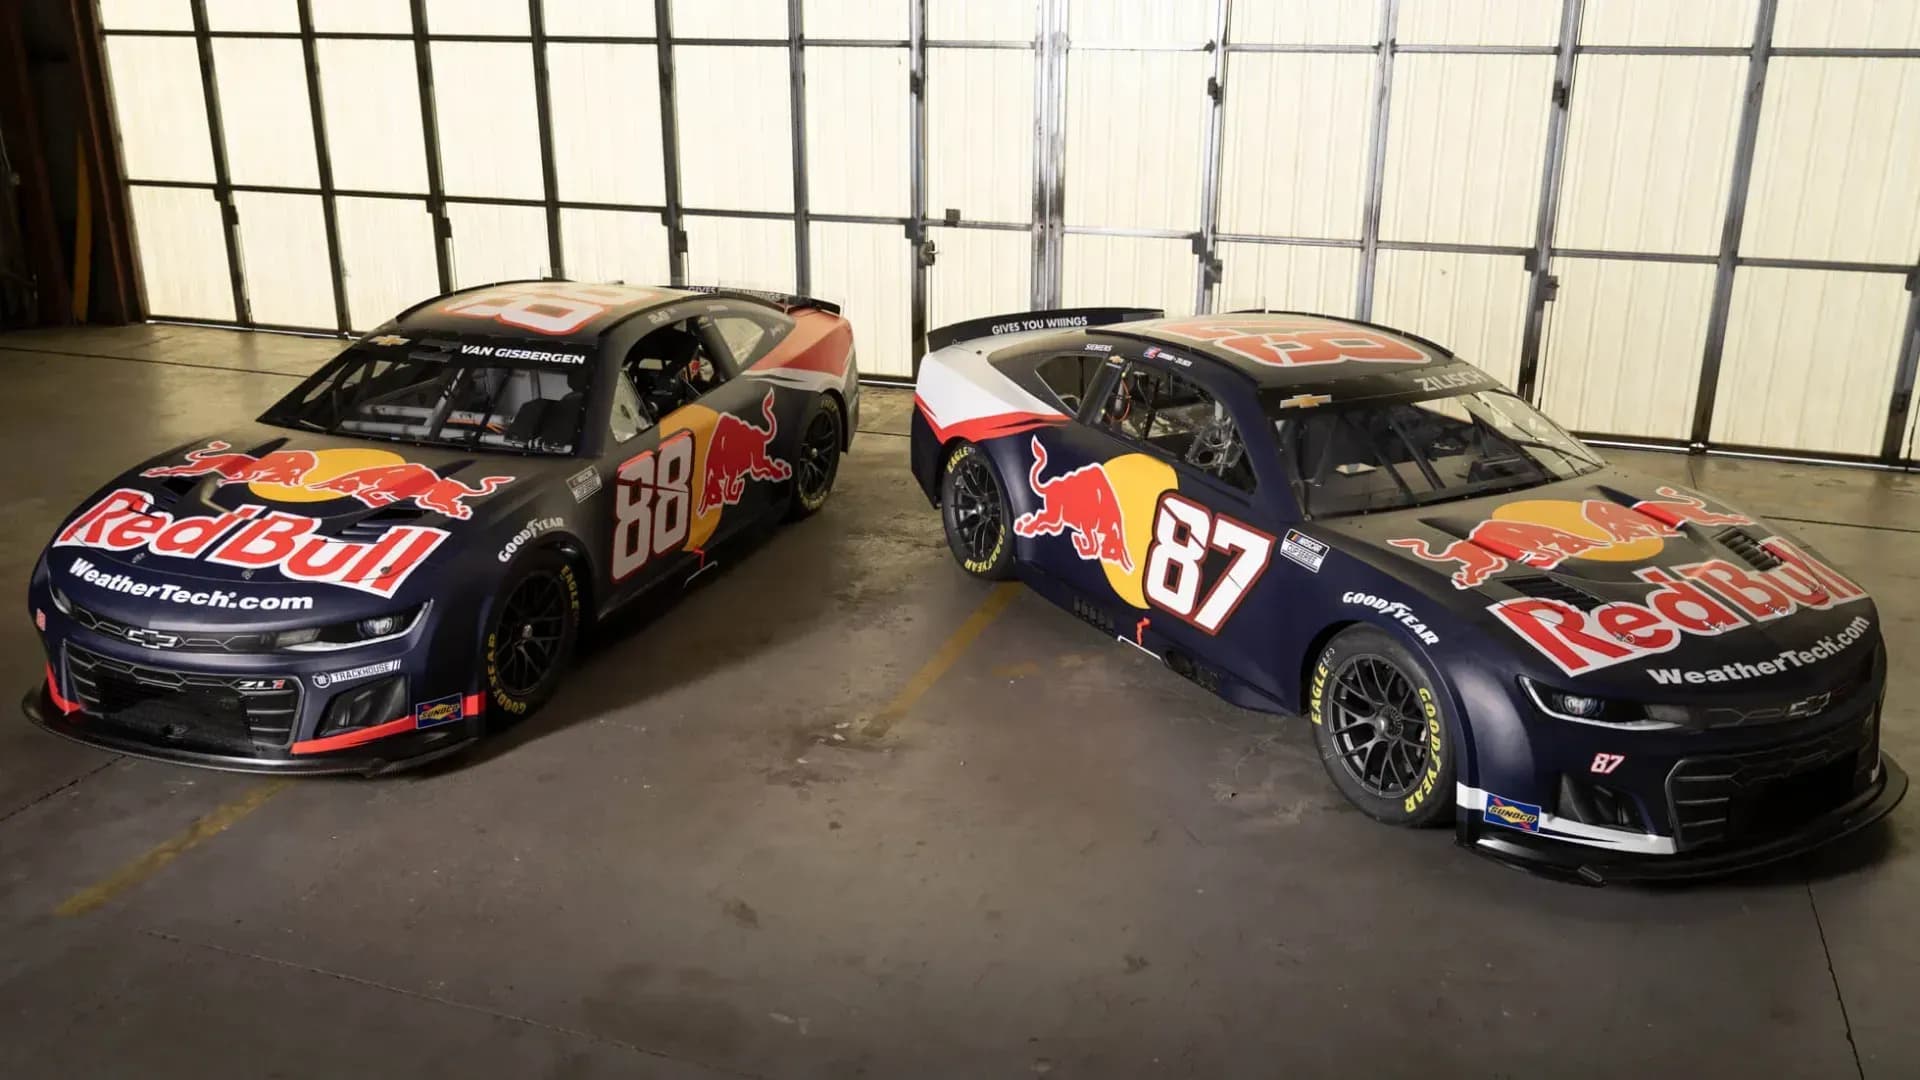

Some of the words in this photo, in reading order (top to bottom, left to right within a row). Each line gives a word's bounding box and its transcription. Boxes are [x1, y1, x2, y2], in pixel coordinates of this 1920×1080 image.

[992, 322, 1020, 335] GIVES
[1022, 319, 1044, 330] YOU
[460, 344, 494, 356] VAN
[494, 347, 586, 365] GISBERGEN
[1413, 369, 1486, 392] ZILISCH
[946, 446, 969, 473] EAGLE
[611, 430, 695, 583] 88
[52, 489, 267, 558] Red
[205, 511, 451, 598] Bull
[498, 517, 567, 563] GOODYEAR
[1143, 490, 1276, 635] 87
[69, 557, 313, 610] WeatherTech.com
[1486, 564, 1752, 677] Red
[1671, 535, 1869, 622] Bull
[1342, 591, 1440, 646] GOODYEAR
[334, 663, 391, 682] TRACKHOUSE
[1646, 615, 1870, 685] WeatherTech.com
[238, 679, 286, 691] ZL1
[1311, 661, 1329, 726] EAGLE
[418, 703, 461, 720] SUNOCO
[1404, 687, 1442, 813] GOODYEAR
[1590, 752, 1625, 775] 87
[1488, 805, 1538, 824] SUNOCO
